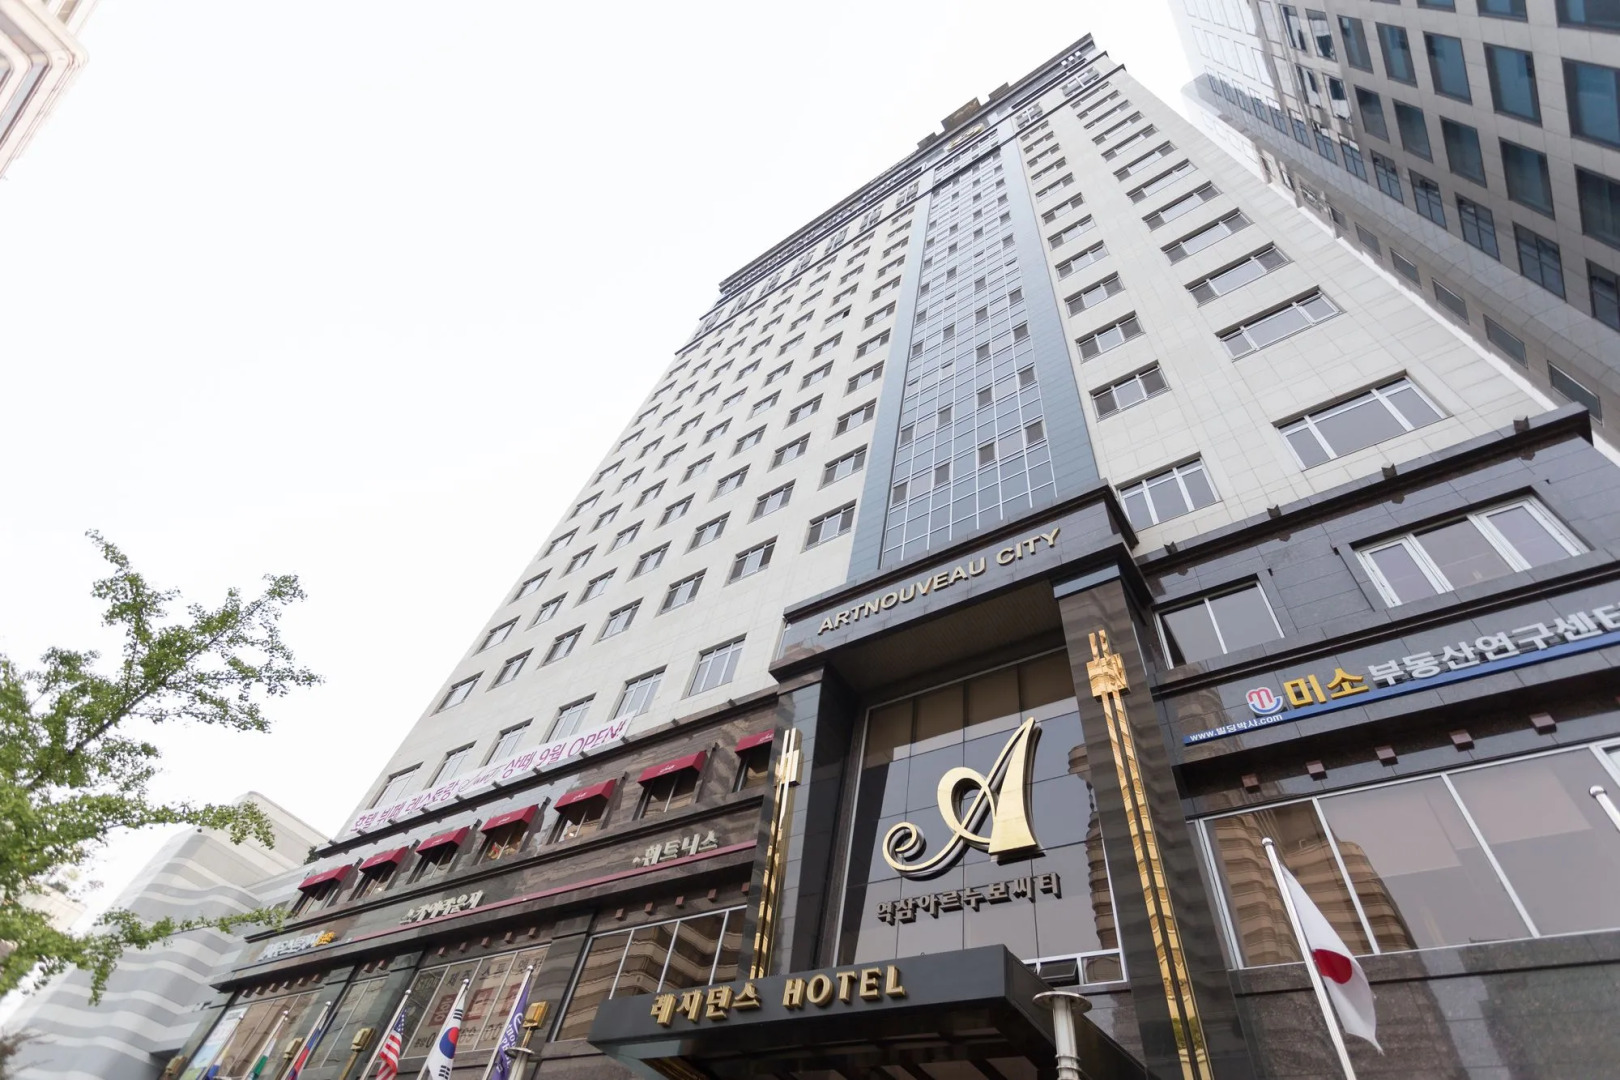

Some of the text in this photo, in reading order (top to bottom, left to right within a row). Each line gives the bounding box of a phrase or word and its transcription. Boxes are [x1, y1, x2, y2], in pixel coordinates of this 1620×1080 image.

[817, 527, 1061, 635] ARTNOUVEAU CITY
[536, 742, 567, 767] 9월
[650, 964, 906, 1027] 레지던스 HOTEL
